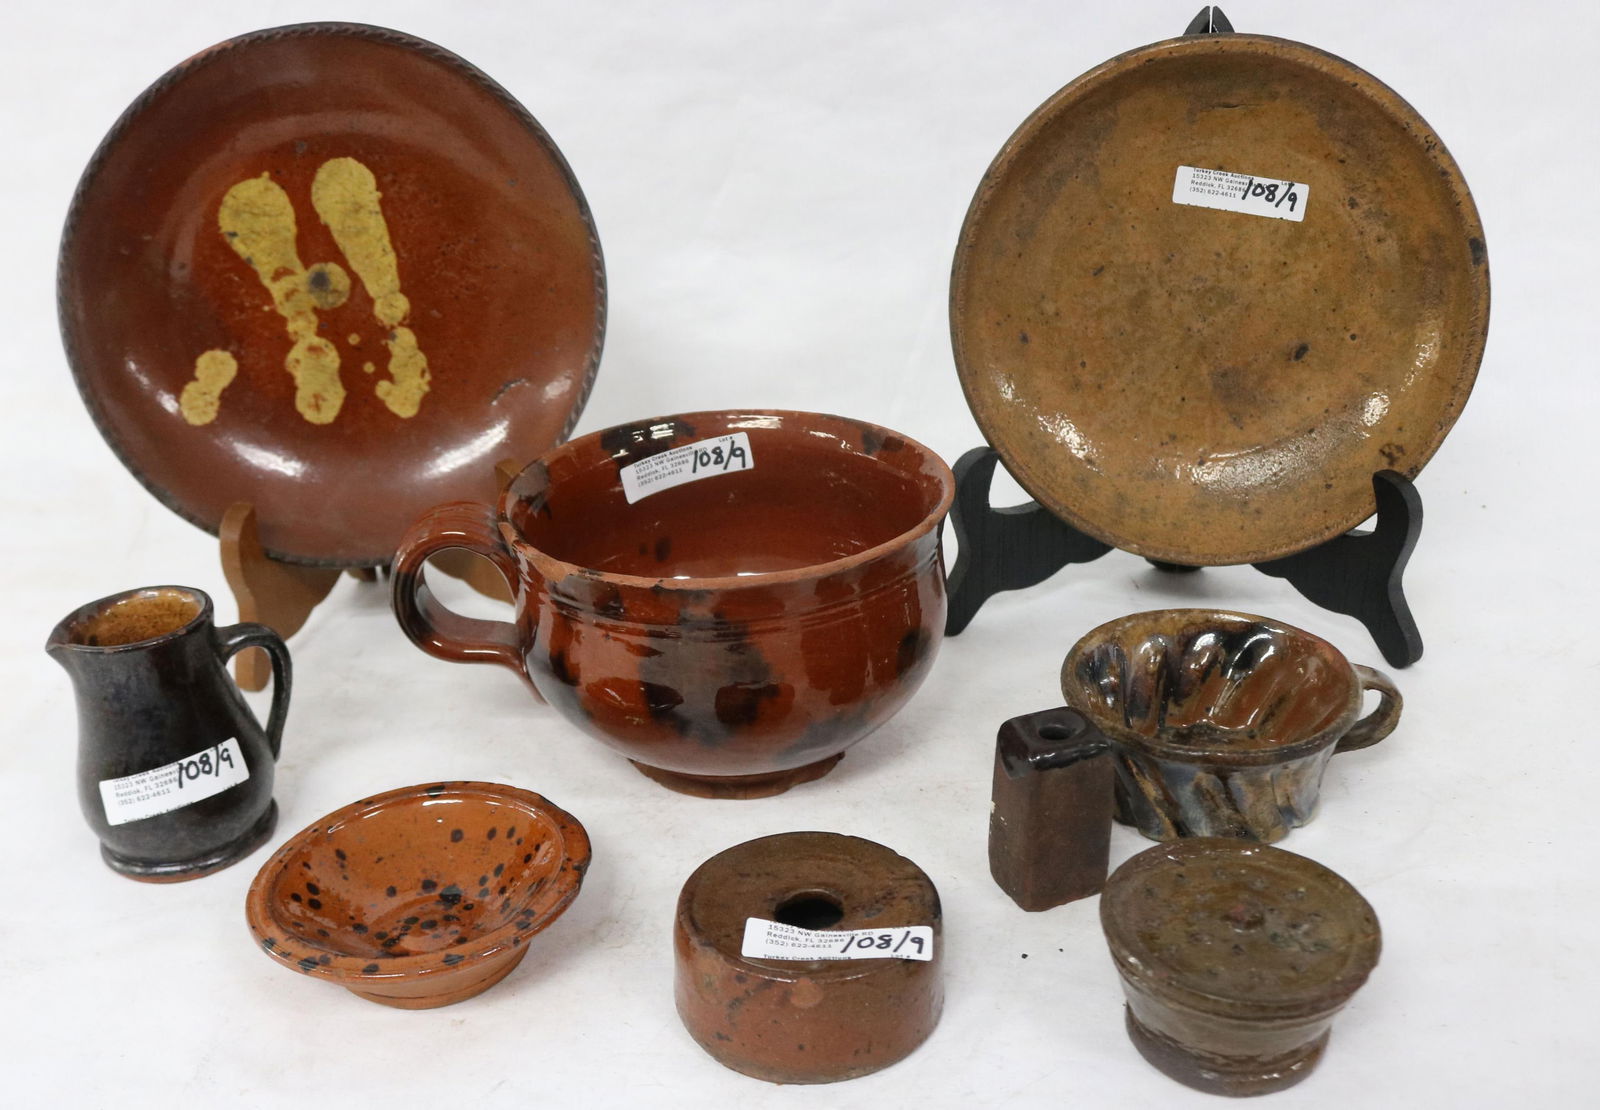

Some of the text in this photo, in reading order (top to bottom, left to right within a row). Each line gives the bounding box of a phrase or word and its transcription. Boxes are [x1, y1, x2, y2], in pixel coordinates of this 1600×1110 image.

[1192, 173, 1211, 181] 15323
[1207, 189, 1236, 199] 622-4611
[1241, 179, 1298, 212] 108/9
[692, 440, 746, 474] 108/9
[177, 745, 234, 789] 108/9
[767, 924, 795, 934] 15323
[840, 930, 924, 954] 108/9
